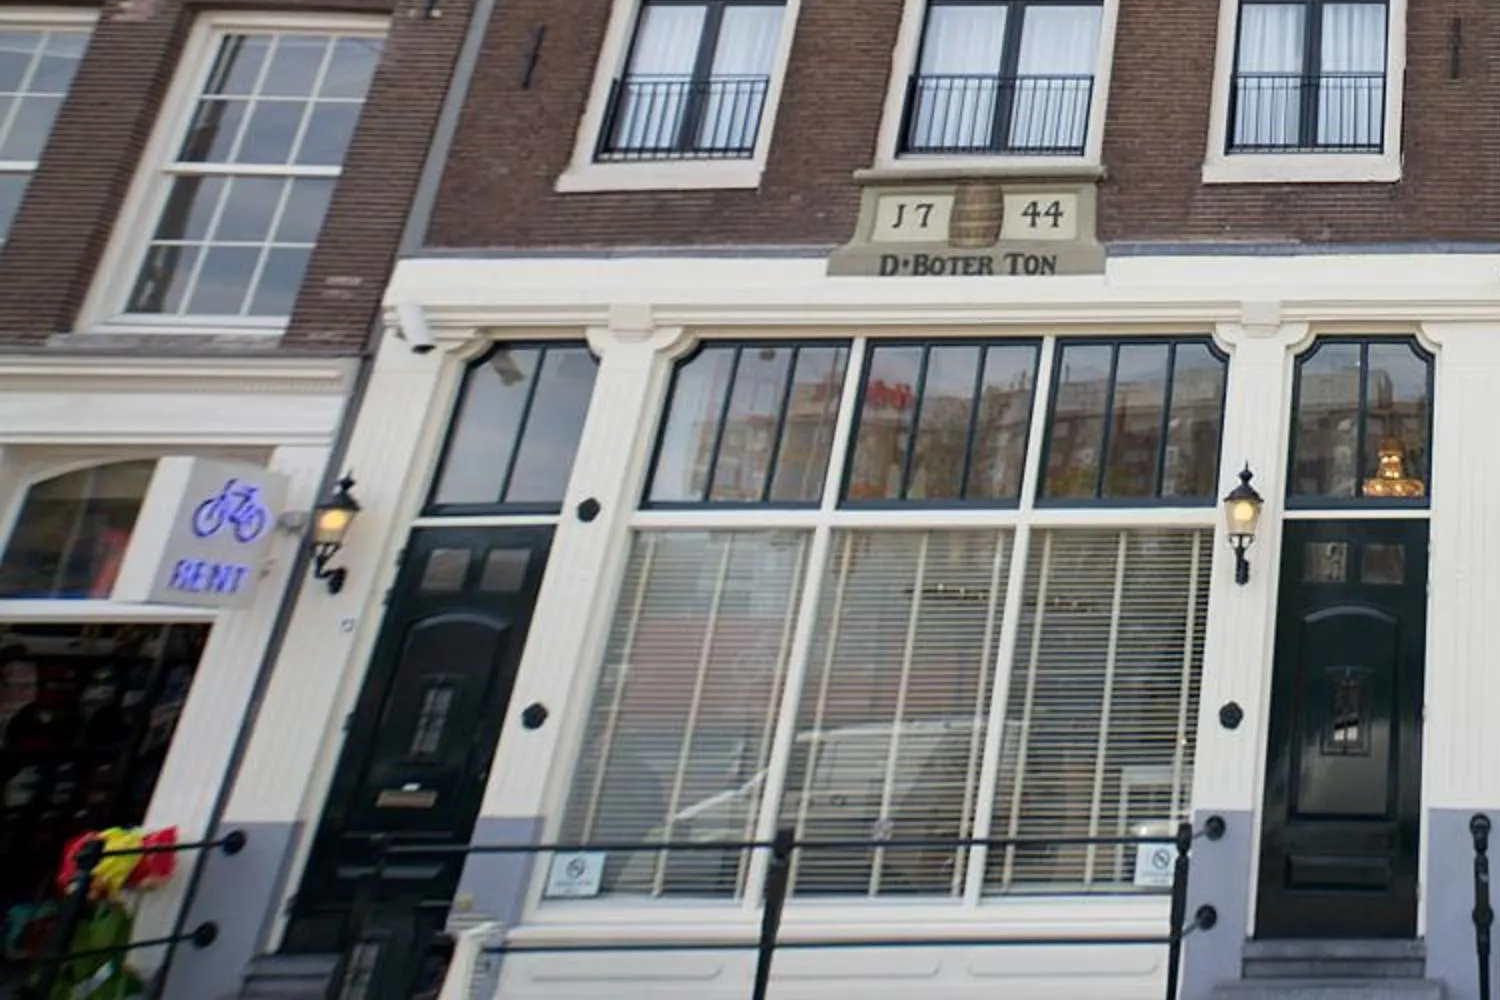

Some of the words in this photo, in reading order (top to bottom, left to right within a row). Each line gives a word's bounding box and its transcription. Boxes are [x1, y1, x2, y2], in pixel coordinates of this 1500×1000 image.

[1021, 200, 1064, 228] 44
[1004, 252, 1057, 277] TON
[167, 559, 250, 594] RENT
